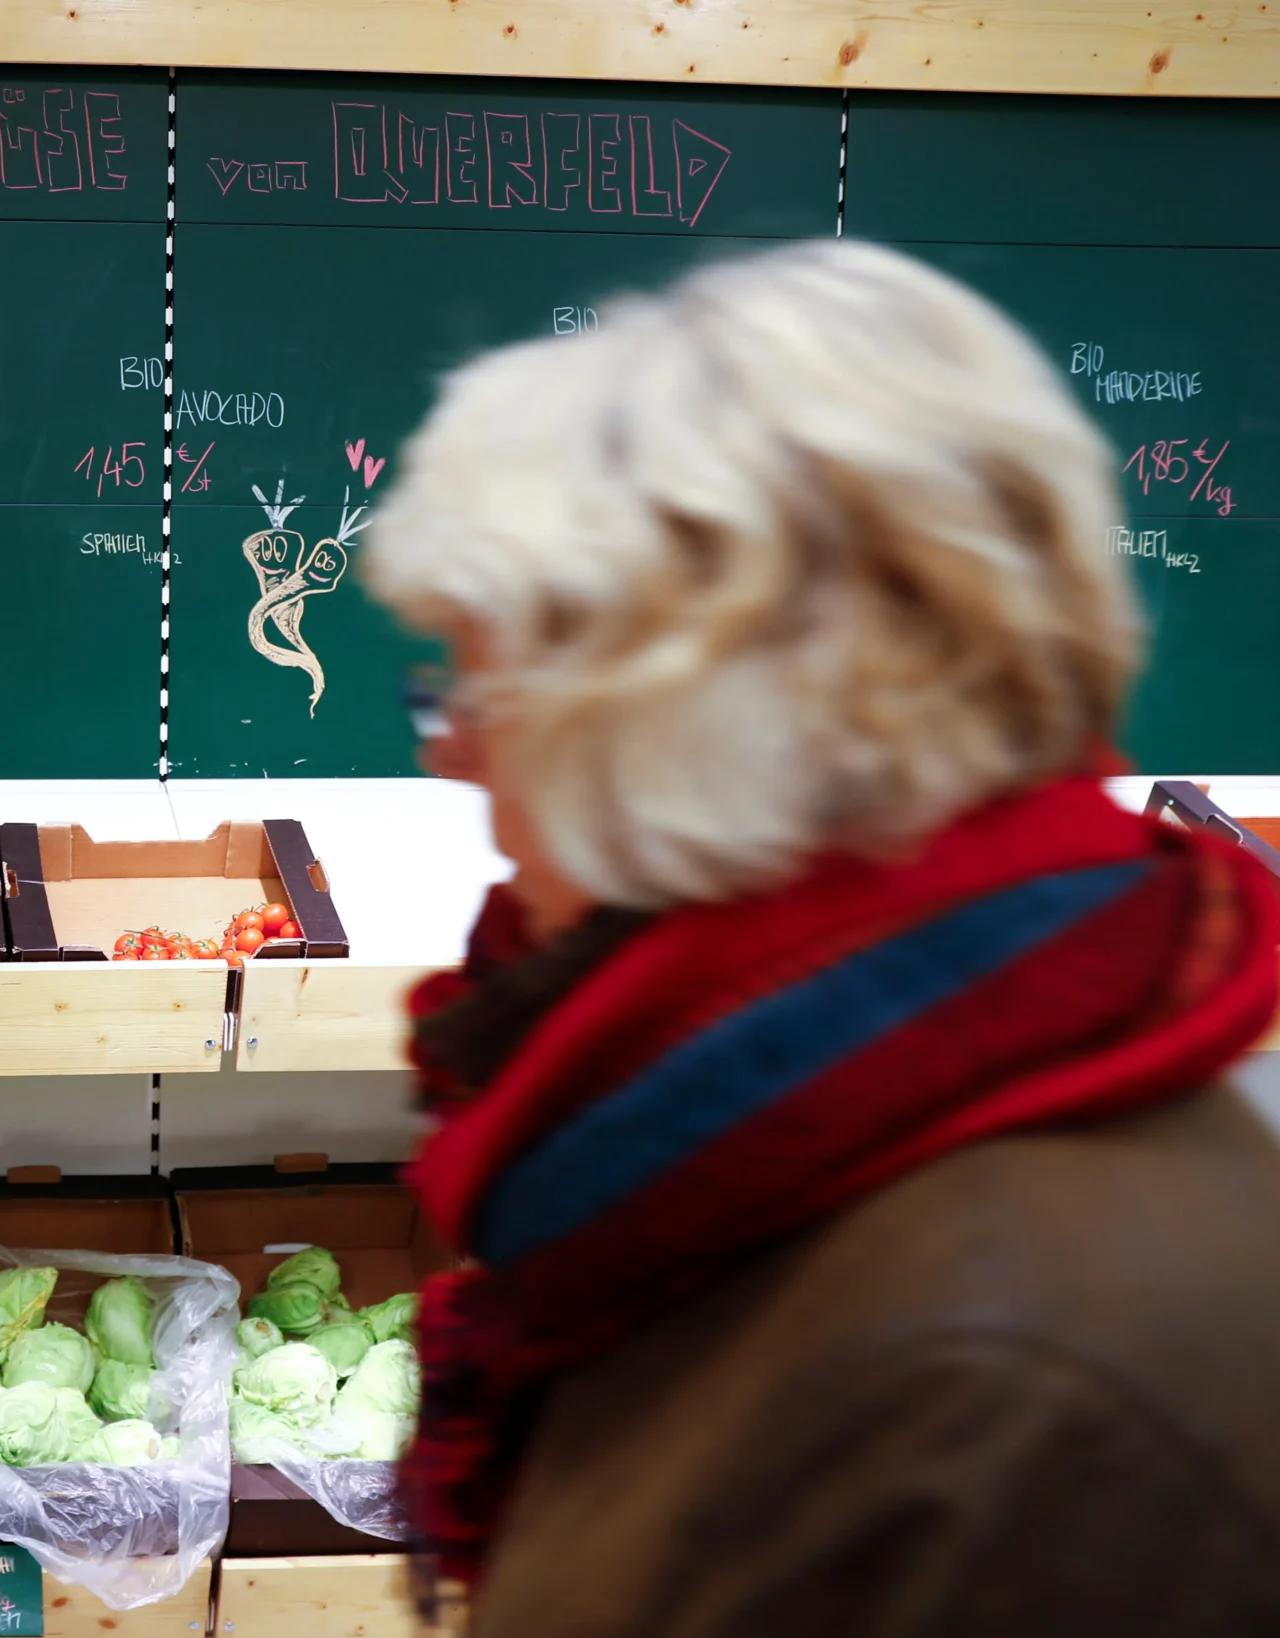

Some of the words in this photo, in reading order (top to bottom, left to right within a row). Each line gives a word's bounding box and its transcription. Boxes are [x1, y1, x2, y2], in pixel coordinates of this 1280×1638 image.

[332, 102, 731, 227] QUERFELD
[553, 305, 599, 337] BIO
[120, 356, 164, 391] BIO
[1070, 341, 1104, 376] BIO
[176, 390, 285, 430] AVOCADO
[80, 532, 146, 556] SPANIEN
